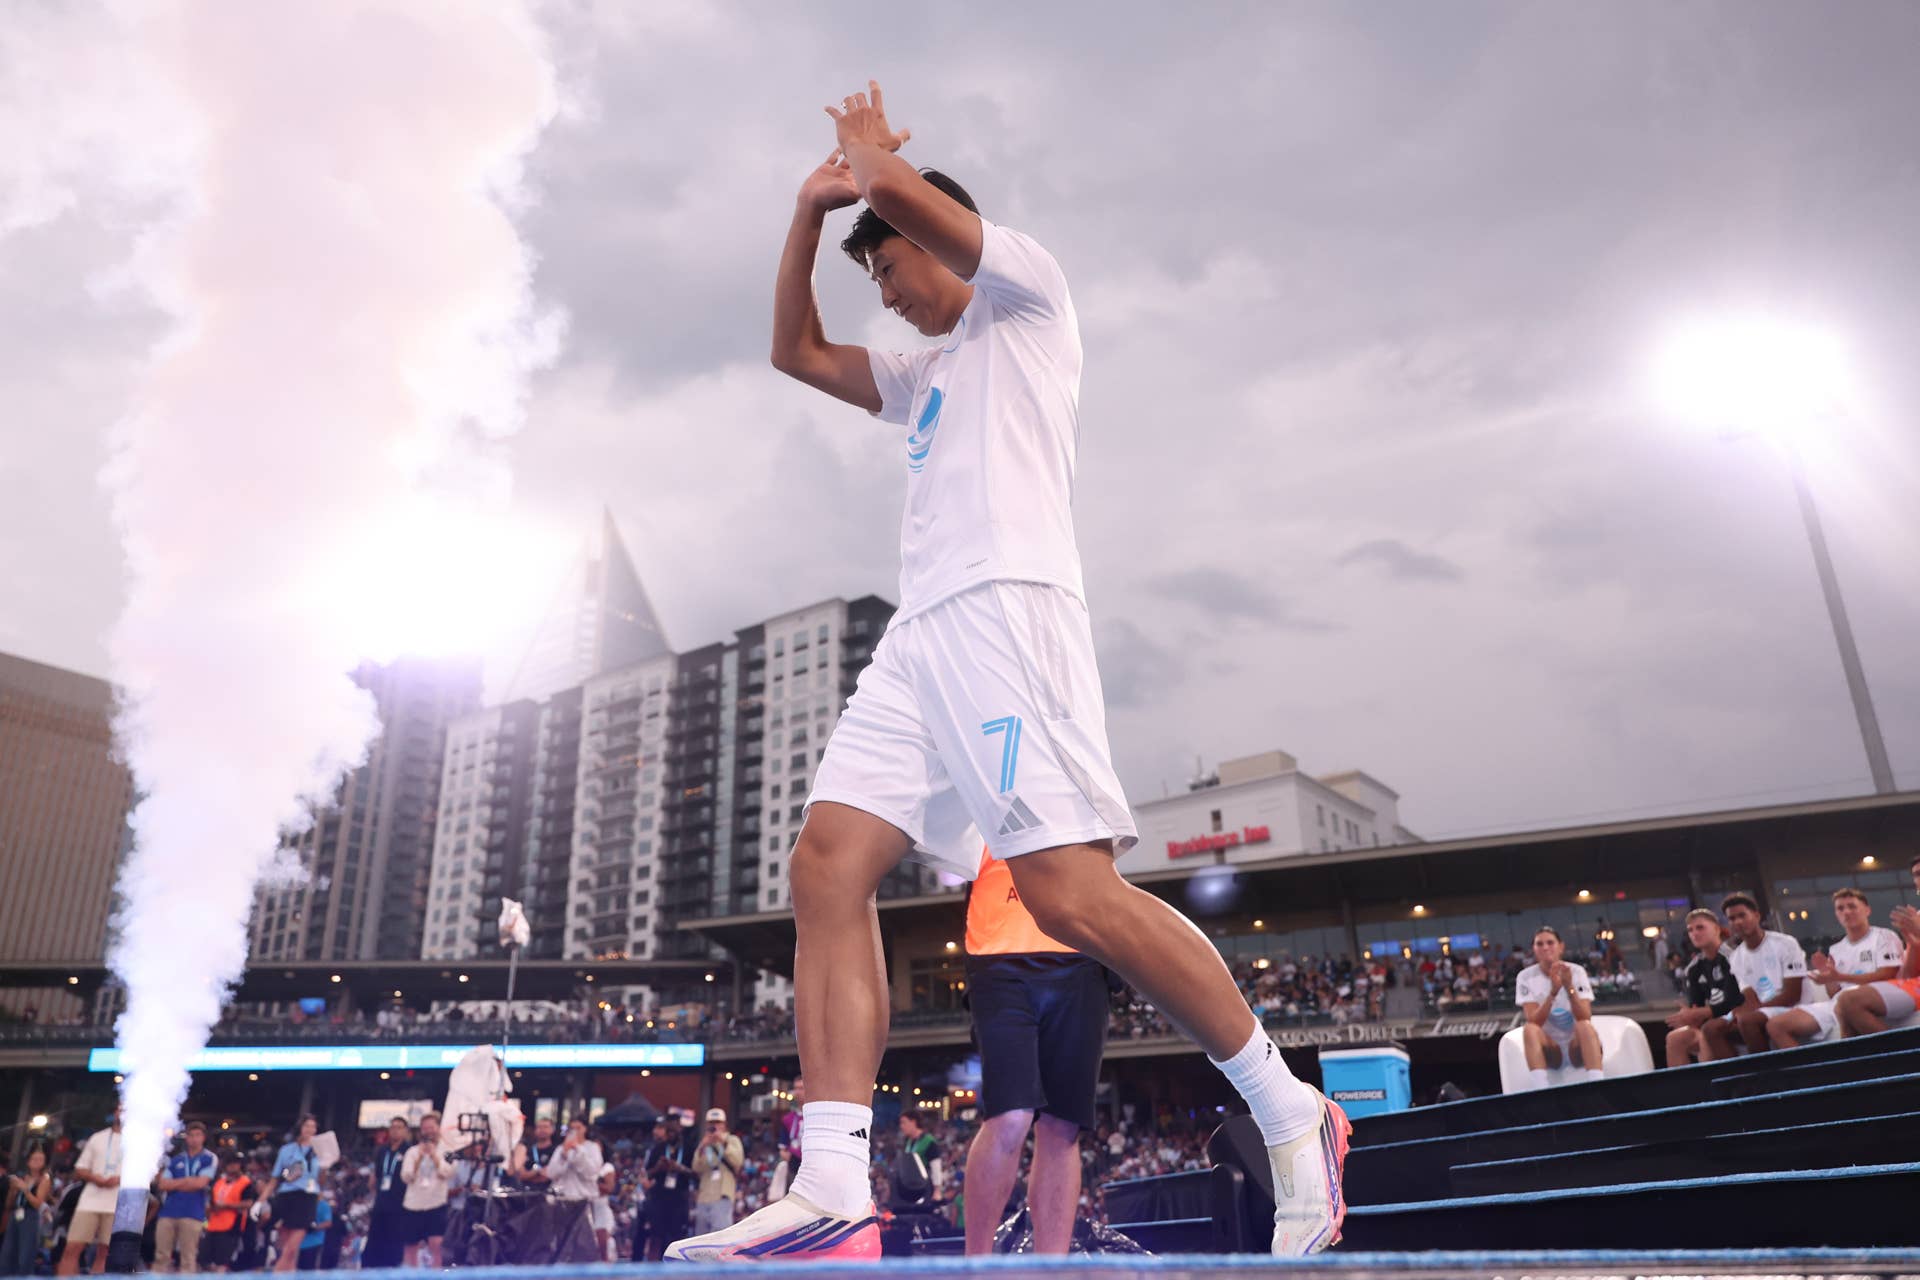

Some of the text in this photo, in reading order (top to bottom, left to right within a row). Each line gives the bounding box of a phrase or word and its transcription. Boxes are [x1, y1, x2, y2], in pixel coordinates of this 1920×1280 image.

[981, 715, 1022, 794] 7
[1425, 1017, 1499, 1039] Luxury
[1333, 1090, 1384, 1100] POWERADE
